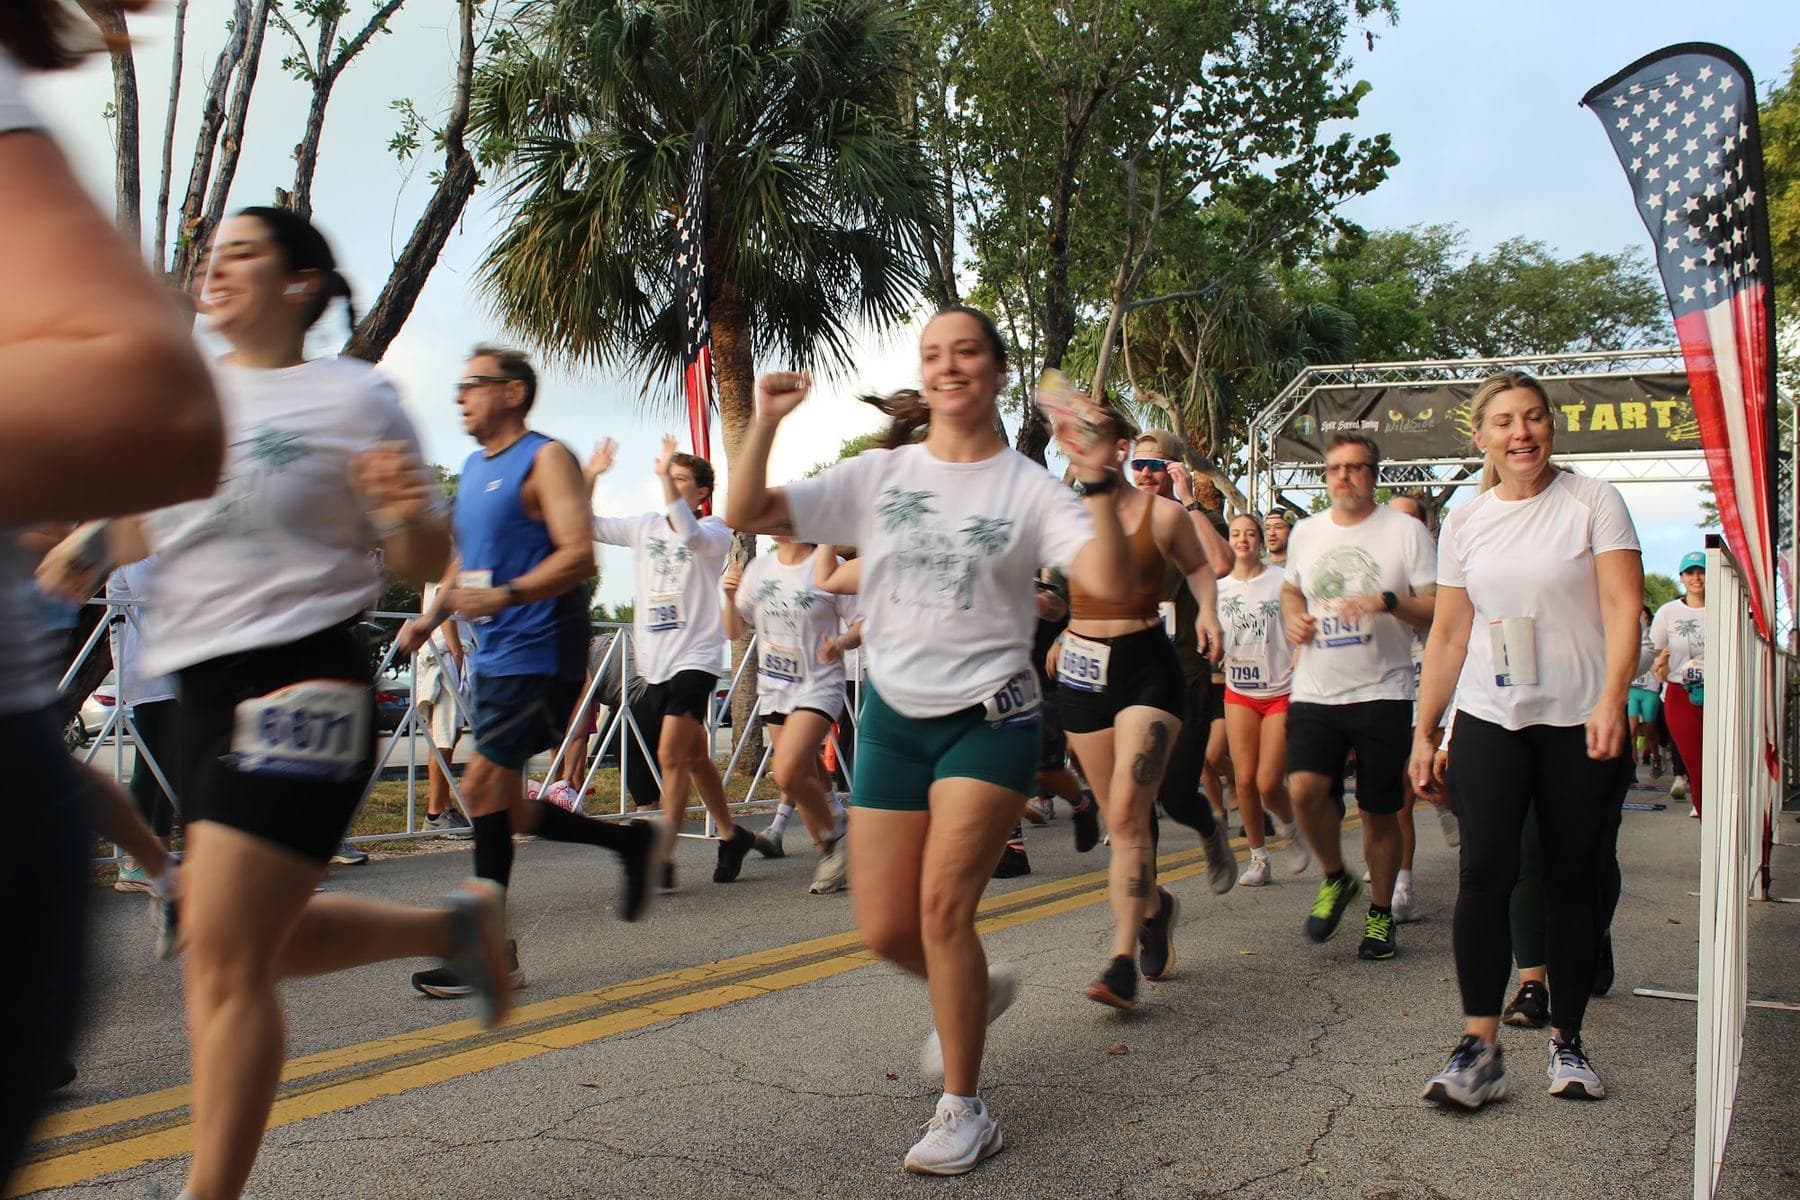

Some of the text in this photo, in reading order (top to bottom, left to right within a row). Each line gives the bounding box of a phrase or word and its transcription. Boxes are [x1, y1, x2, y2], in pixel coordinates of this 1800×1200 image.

[1557, 398, 1677, 432] TART
[1230, 666, 1260, 680] 7794
[1687, 667, 1704, 680] 85
